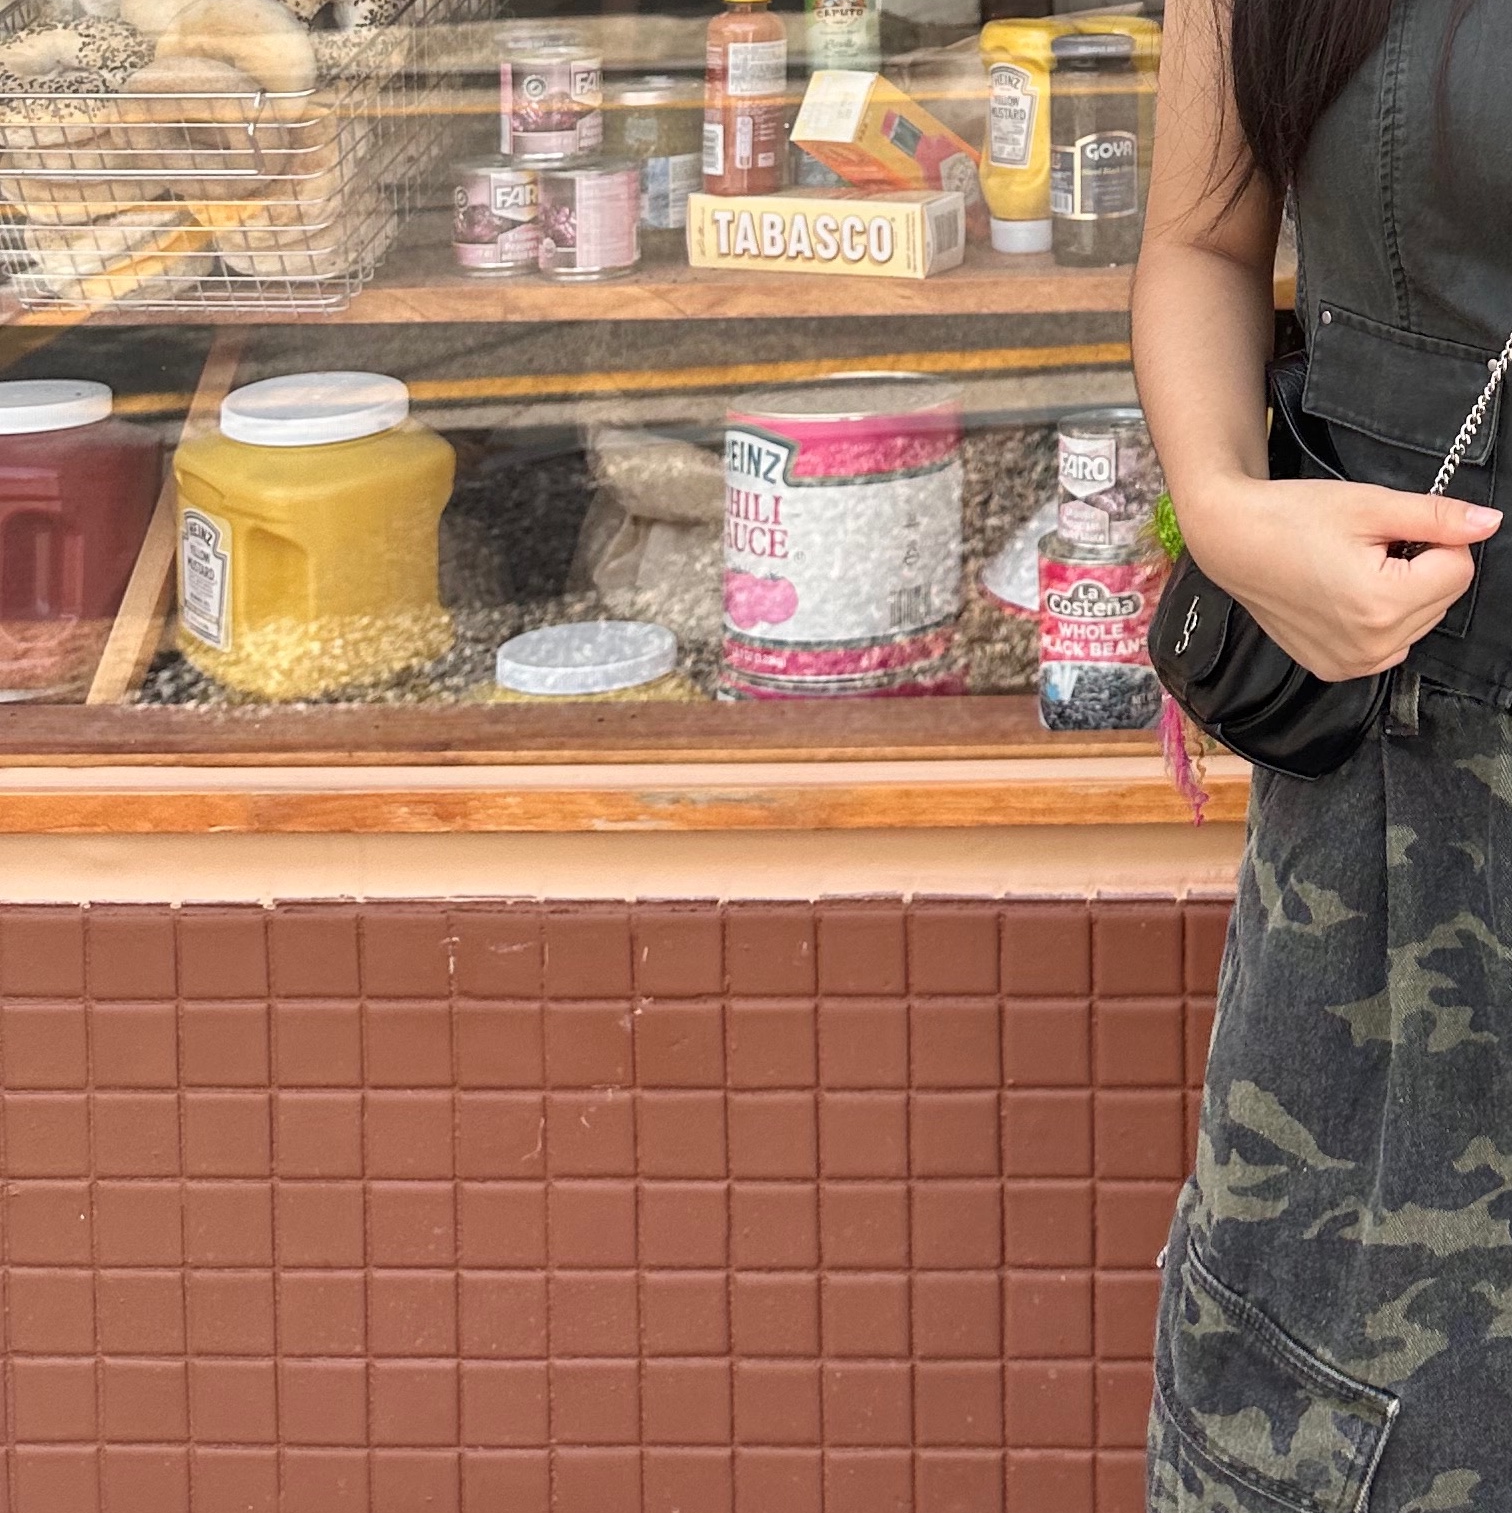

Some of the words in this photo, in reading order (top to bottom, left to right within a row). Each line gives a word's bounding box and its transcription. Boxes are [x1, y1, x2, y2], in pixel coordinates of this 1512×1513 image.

[1085, 140, 1133, 161] GOYA
[711, 209, 894, 263] TABASCO
[1078, 586, 1099, 600] La
[1057, 620, 1124, 639] WHOLE
